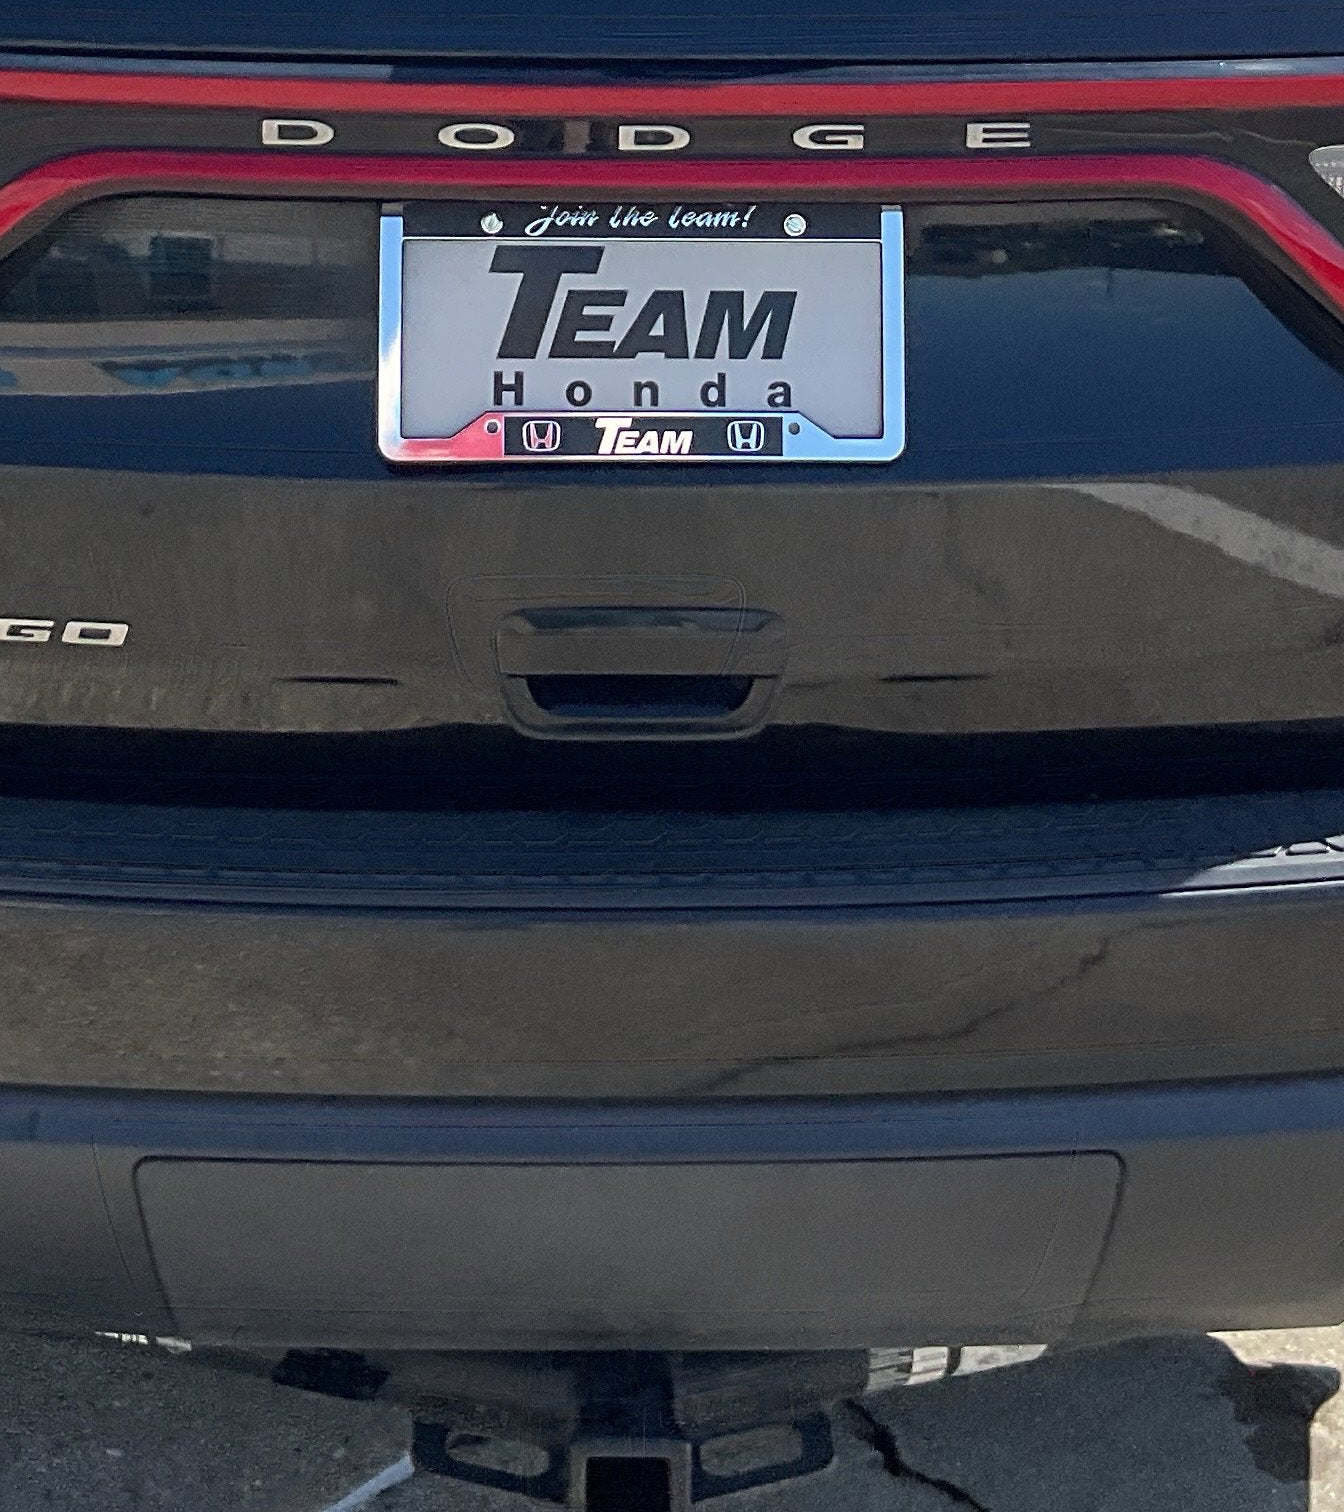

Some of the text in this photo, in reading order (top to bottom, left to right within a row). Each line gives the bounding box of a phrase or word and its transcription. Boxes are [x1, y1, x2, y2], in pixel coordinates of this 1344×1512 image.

[261, 118, 1032, 151] DODGE
[609, 204, 658, 229] the
[488, 244, 798, 360] TEAM
[493, 370, 792, 408] Honda
[594, 417, 694, 455] TEAM
